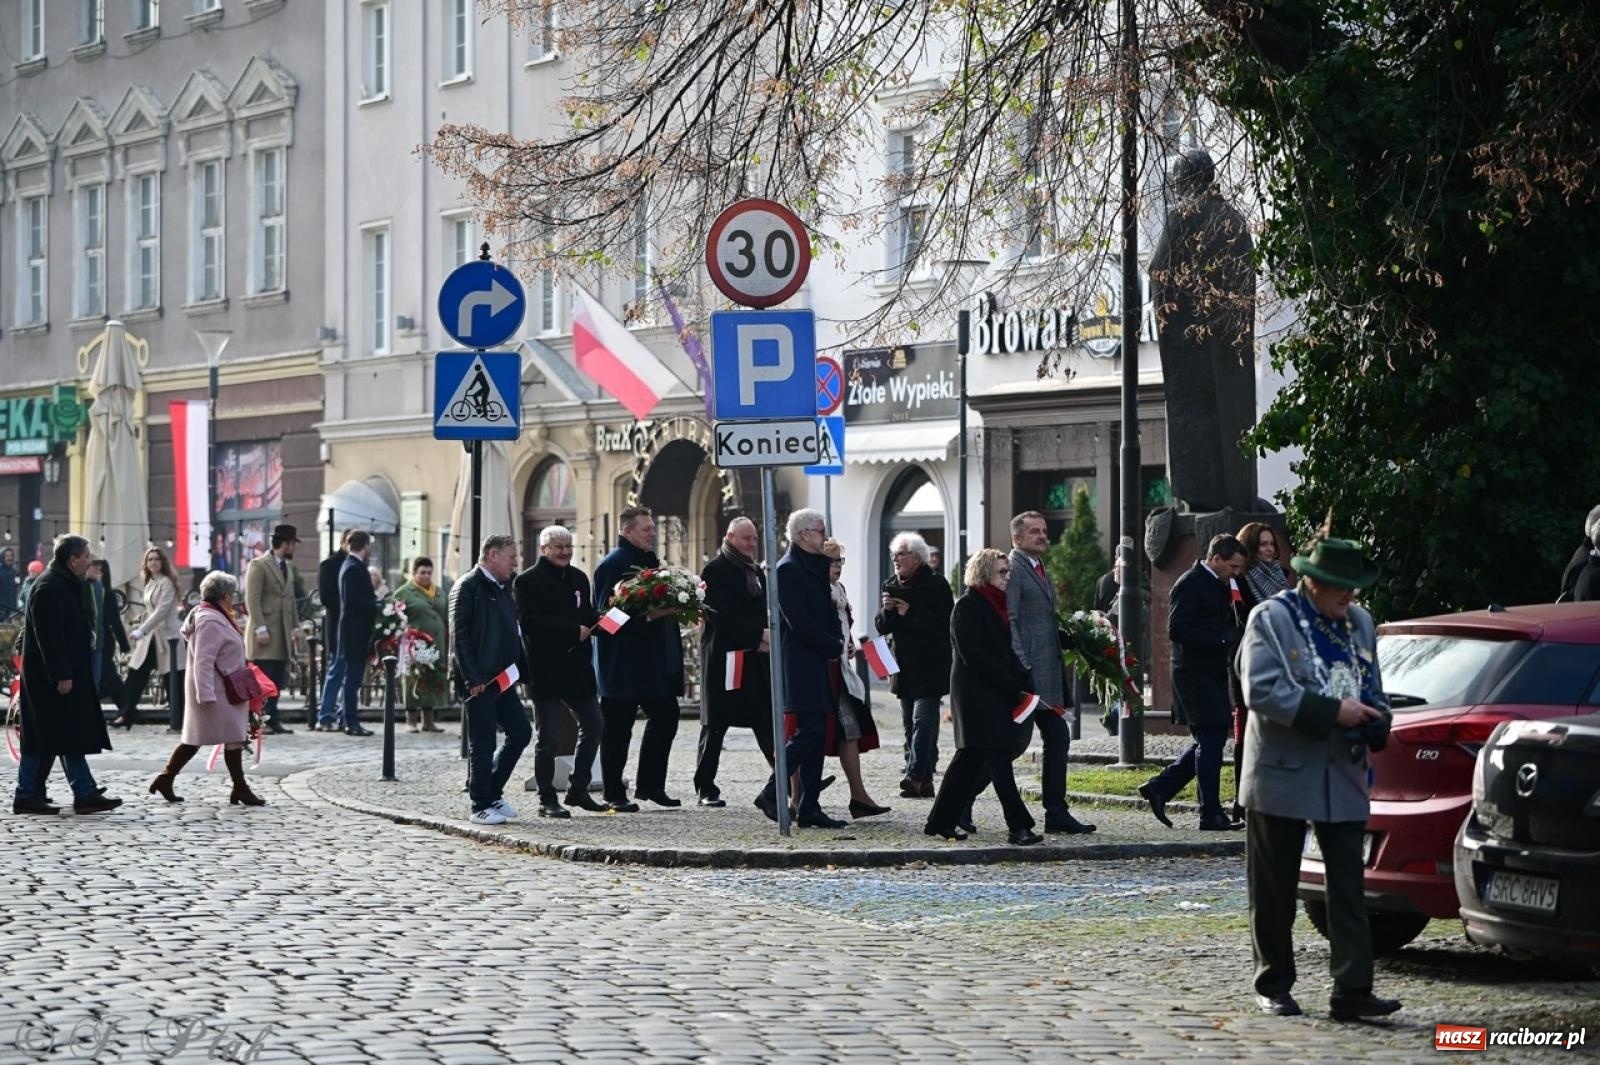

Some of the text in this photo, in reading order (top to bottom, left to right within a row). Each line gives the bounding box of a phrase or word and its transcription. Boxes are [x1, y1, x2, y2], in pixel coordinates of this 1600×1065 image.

[725, 229, 795, 278] 30
[972, 291, 1073, 354] Browar
[737, 324, 794, 406] P
[889, 370, 954, 409] Wypieki
[718, 430, 816, 456] Koniec
[1492, 876, 1521, 901] SRC
